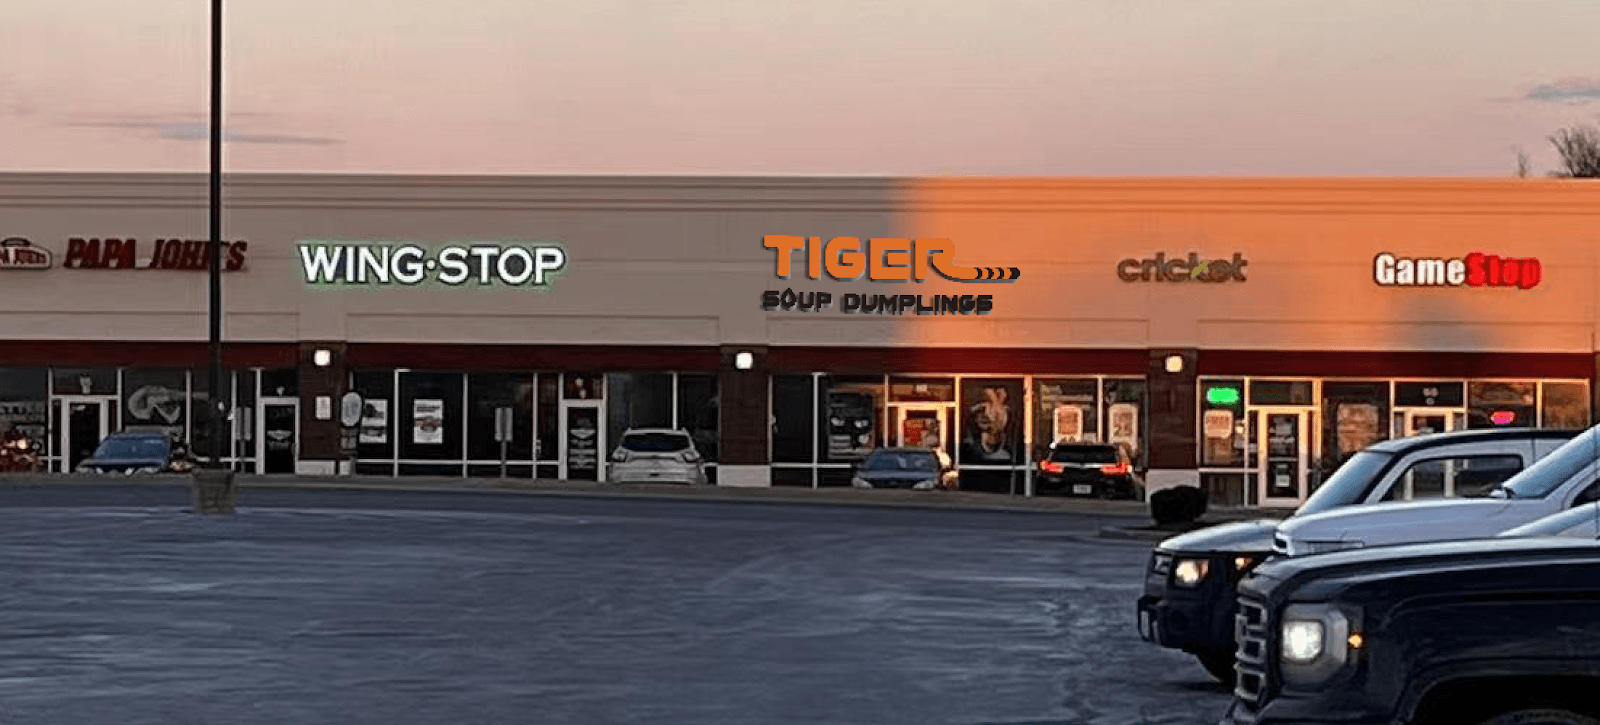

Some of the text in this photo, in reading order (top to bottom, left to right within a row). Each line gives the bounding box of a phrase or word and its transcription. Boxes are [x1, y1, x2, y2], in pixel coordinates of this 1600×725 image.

[64, 238, 136, 269] PAPA
[763, 235, 1020, 282] TIGER
[1117, 252, 1248, 282] cricket
[1374, 252, 1542, 289] GameStop
[762, 288, 993, 315] SOUP DUMPLINGS
